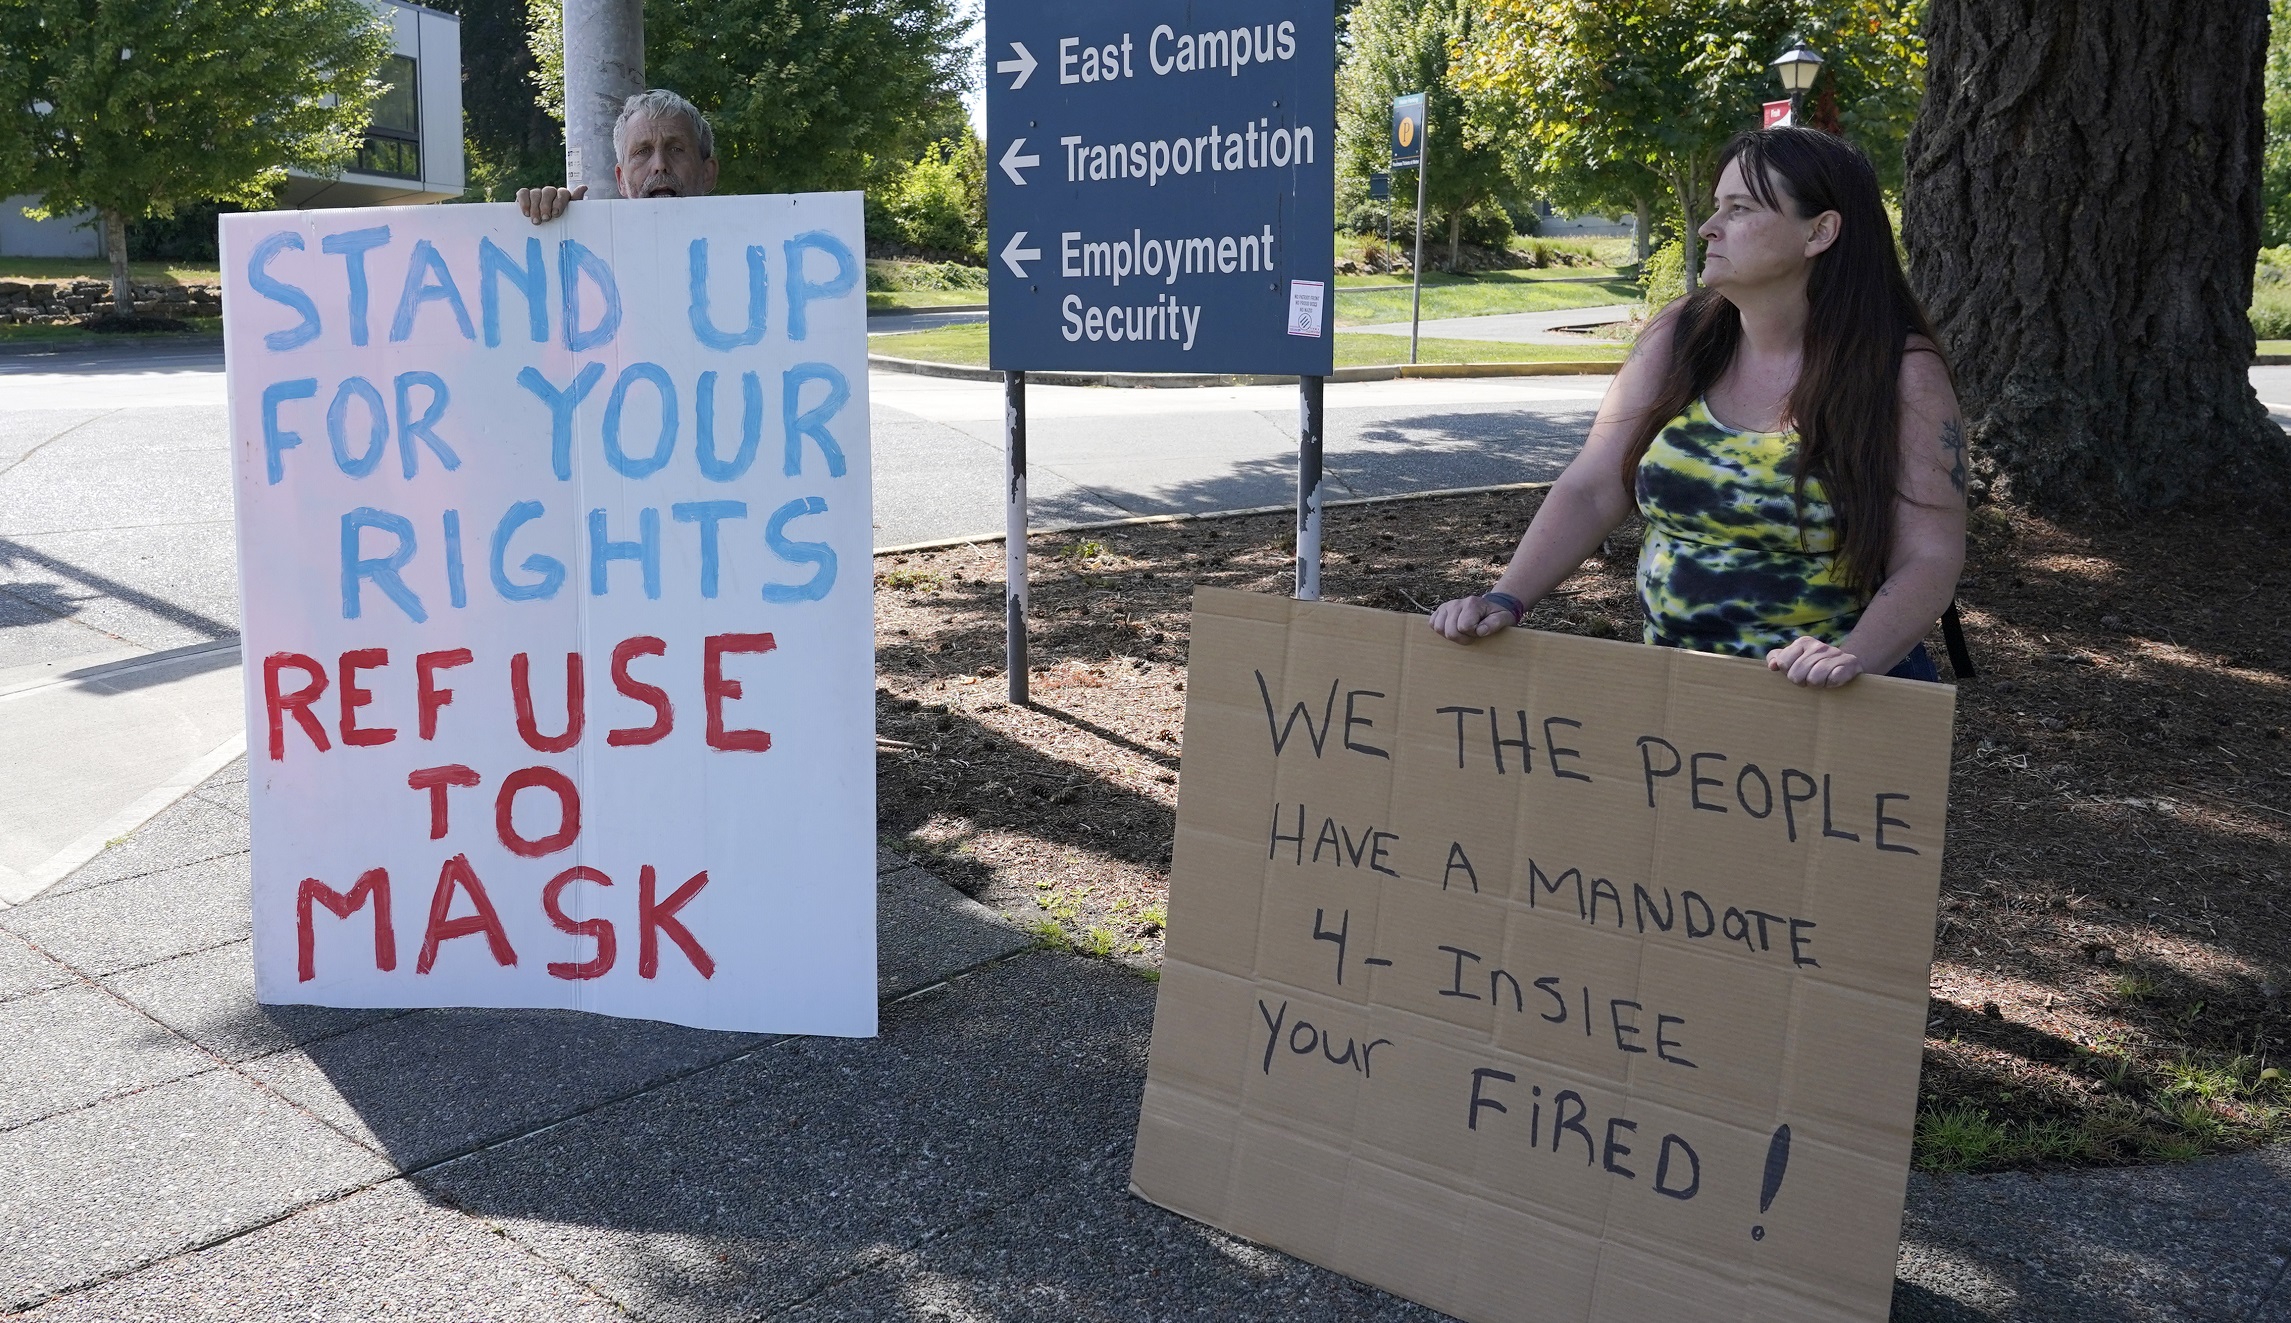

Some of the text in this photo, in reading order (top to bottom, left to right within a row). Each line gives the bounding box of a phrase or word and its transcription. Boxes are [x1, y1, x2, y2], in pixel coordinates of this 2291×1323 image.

[1060, 21, 1295, 84] East Campus
[1061, 118, 1313, 186] Transportation
[1404, 122, 1410, 142] P
[248, 225, 859, 352] STAND UP
[1062, 225, 1274, 286] Employment
[1062, 294, 1200, 350] Security
[262, 361, 851, 485] FOR YOUR
[341, 497, 838, 623] RIGHTS
[264, 632, 777, 761] REFUSE
[1255, 669, 1920, 855] WE THE PEOPLE
[408, 764, 581, 858] TO
[1270, 803, 1400, 878] HAVE
[1443, 842, 1478, 893] A
[296, 853, 716, 983] MASK
